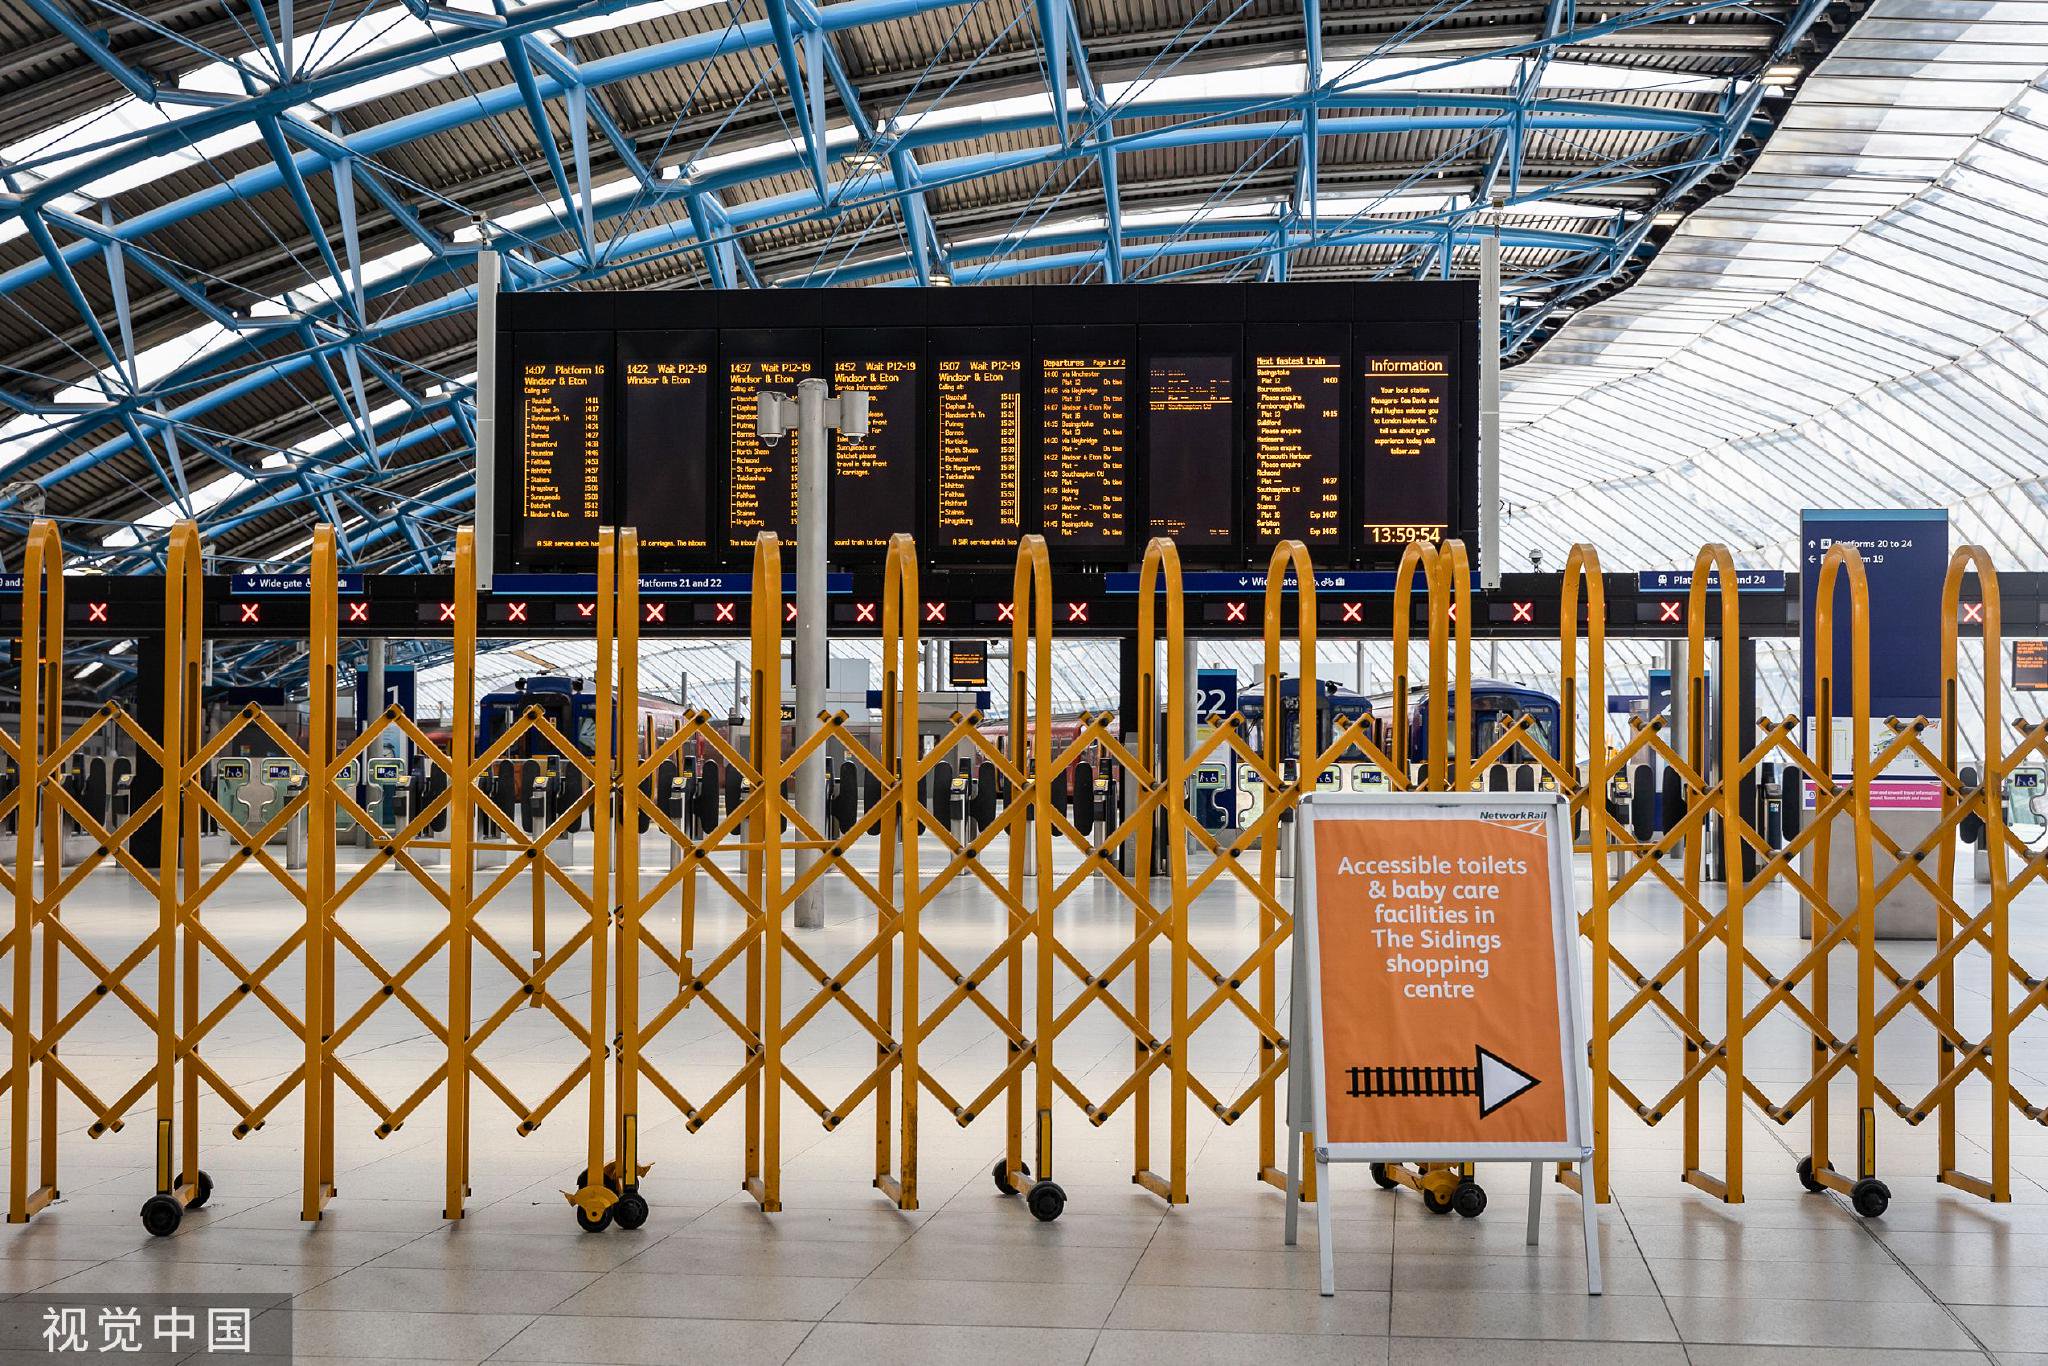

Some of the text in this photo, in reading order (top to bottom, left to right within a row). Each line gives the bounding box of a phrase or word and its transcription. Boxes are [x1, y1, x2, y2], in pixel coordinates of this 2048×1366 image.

[970, 362, 988, 370] Wait
[992, 361, 1020, 370] P12-19
[1257, 357, 1326, 365] Next fastest train
[1372, 359, 1442, 371] Information
[556, 366, 591, 374] Platform
[595, 365, 604, 374] 16
[658, 365, 676, 373] Wait
[679, 364, 707, 373] P12-19
[761, 364, 779, 372] Wait
[782, 364, 810, 372] P12-19
[866, 362, 884, 370] Wait
[887, 362, 915, 370] P12-19
[569, 377, 587, 385] Eton
[627, 376, 659, 384] Windsor
[672, 376, 690, 384] Eton
[731, 375, 762, 383] Windsor
[775, 374, 793, 383] Eton
[835, 374, 867, 382] Windsor
[880, 373, 899, 382] Eton
[939, 373, 971, 381] Windsor
[984, 373, 1003, 381] Eton
[1371, 527, 1441, 543] 13:59:54
[1877, 540, 1888, 548] 20
[1890, 540, 1900, 548] to
[1901, 540, 1912, 548] 24
[1873, 555, 1884, 563] 19
[5, 577, 21, 587] and
[260, 579, 302, 590] Wide gate
[637, 578, 722, 588] Platforms 21 and 22
[1753, 575, 1766, 585] 24
[1196, 689, 1226, 715] 22
[1338, 857, 1527, 875] Accessible toilets
[1368, 880, 1500, 903] & baby care
[1375, 904, 1495, 924] facilities in
[1371, 928, 1502, 953] The Sidings
[1386, 954, 1489, 978] shopping
[1403, 981, 1475, 998] centre
